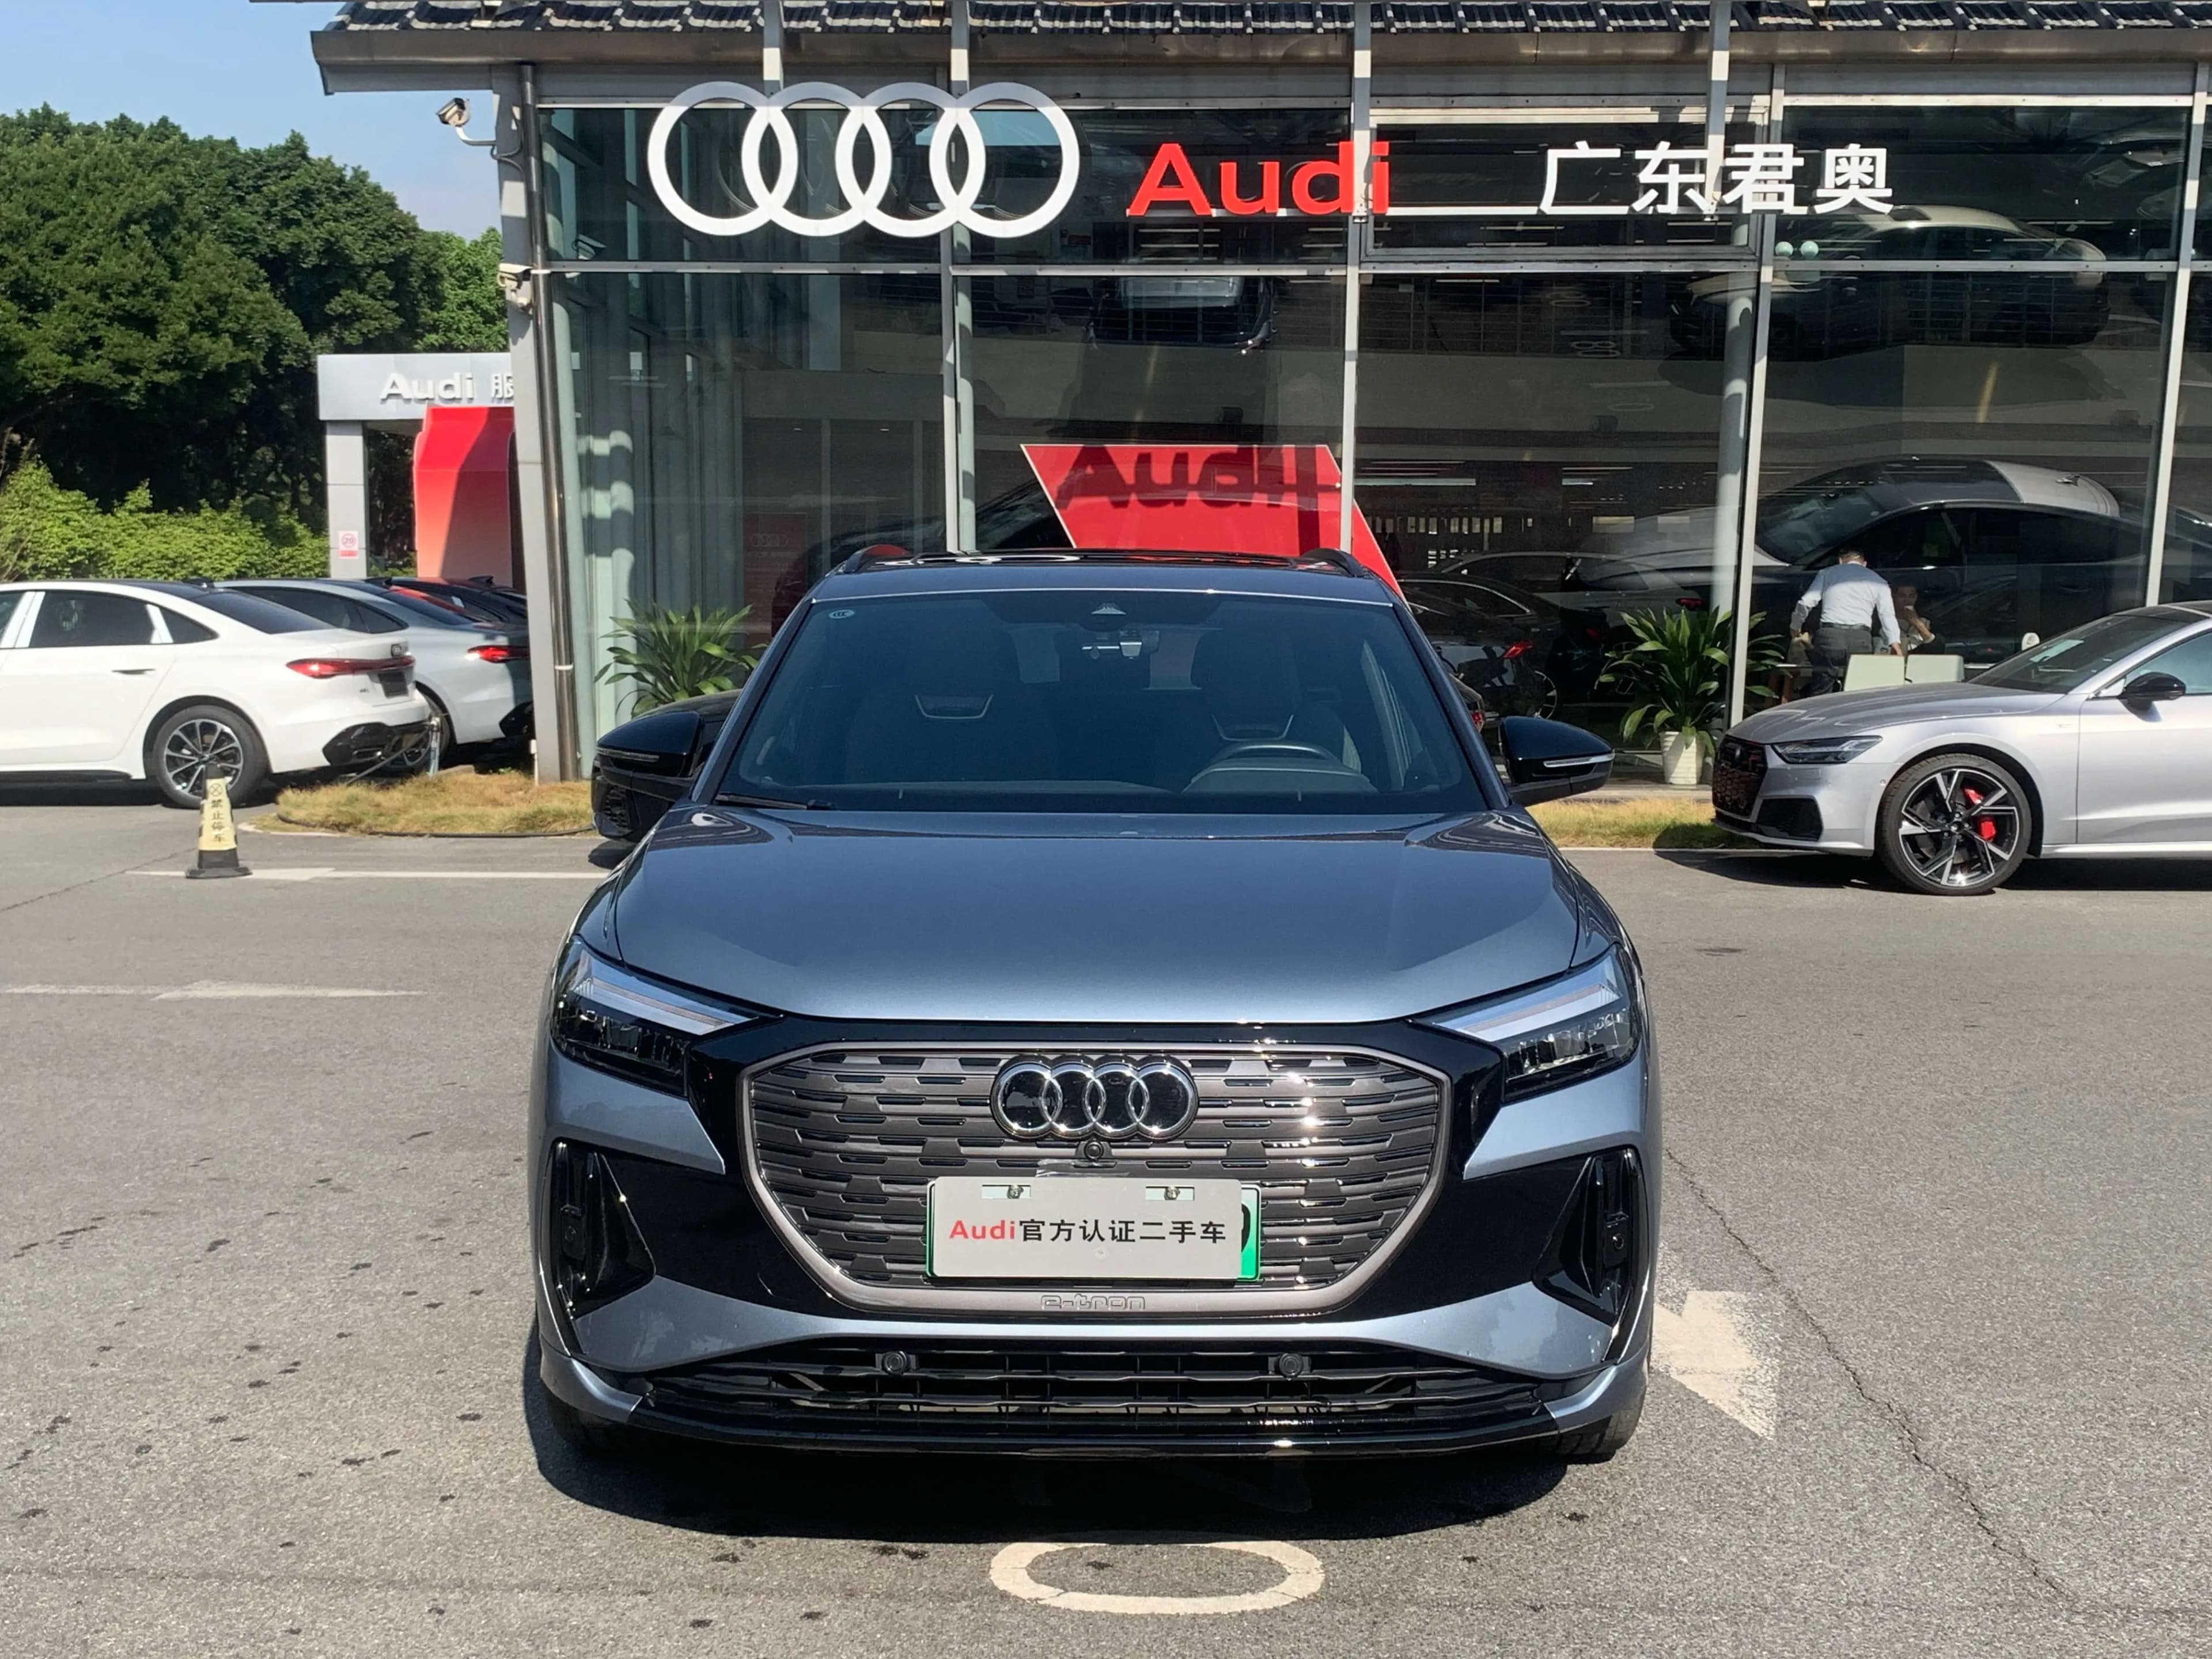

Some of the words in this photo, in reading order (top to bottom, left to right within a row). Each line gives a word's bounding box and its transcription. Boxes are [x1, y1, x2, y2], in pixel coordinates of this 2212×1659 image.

[1127, 141, 1389, 216] Audi
[1538, 141, 1894, 215] 广东君奥
[379, 372, 474, 401] Audi
[1041, 1293, 1146, 1310] e-tron
